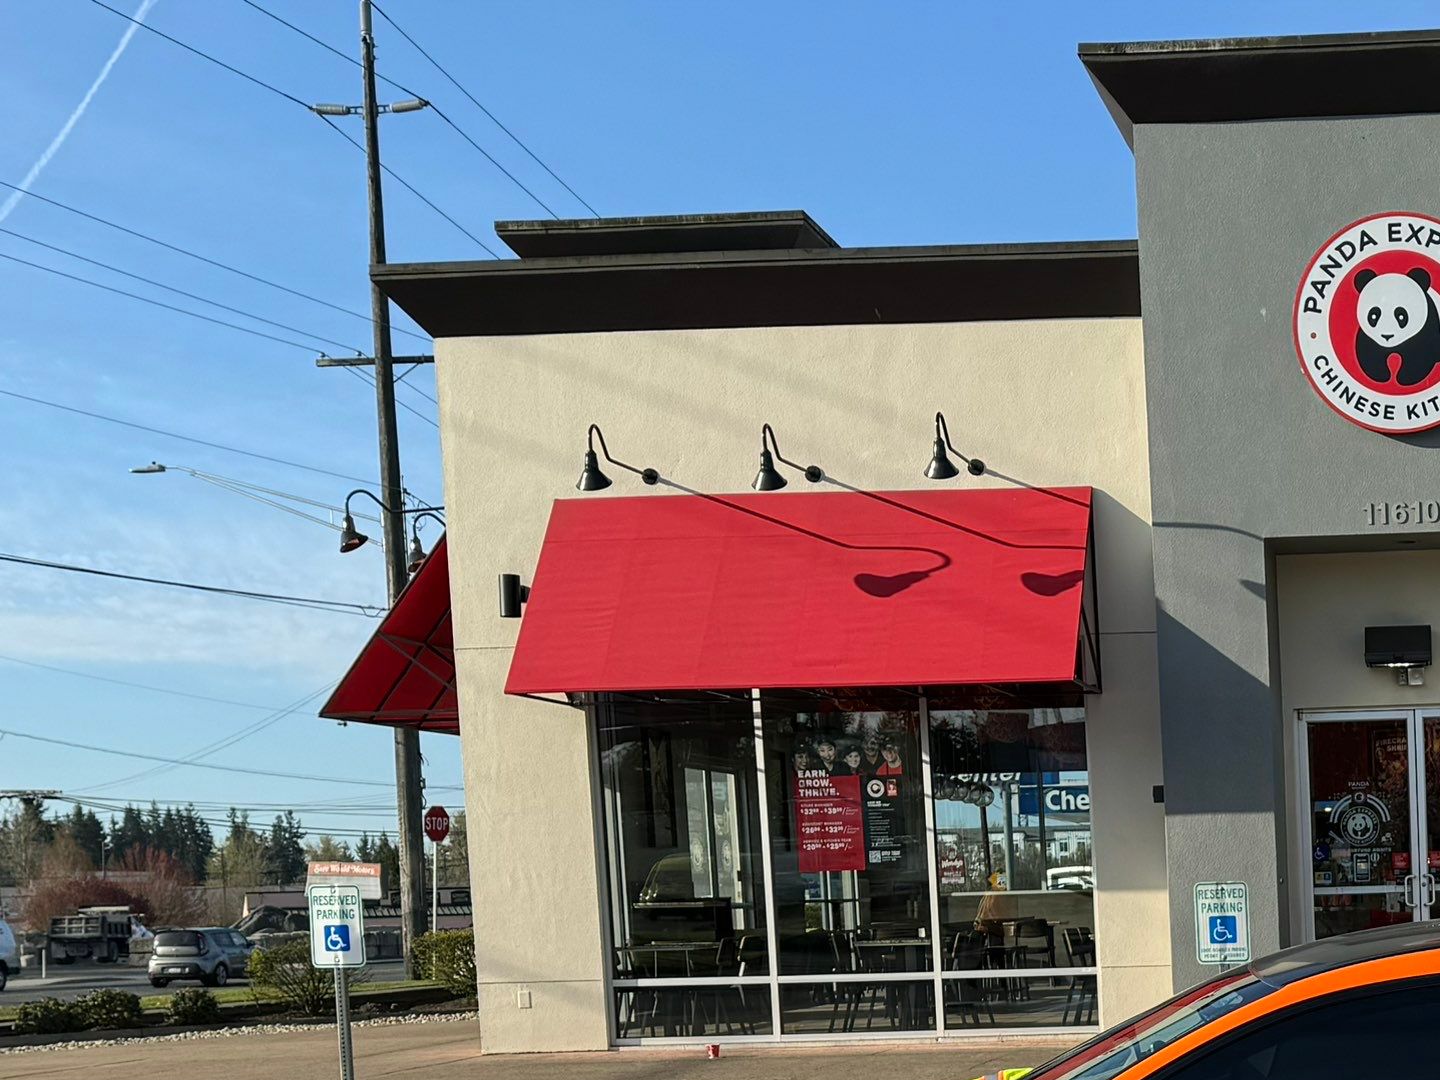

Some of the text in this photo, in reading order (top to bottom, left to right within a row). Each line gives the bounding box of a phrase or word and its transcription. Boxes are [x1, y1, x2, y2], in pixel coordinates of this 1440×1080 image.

[1303, 229, 1378, 314] PANDA
[1313, 355, 1396, 421] CHINESE
[798, 770, 829, 778] EARN.
[799, 788, 839, 797] THRIVE.
[426, 817, 449, 831] STOP
[1198, 888, 1244, 900] RESERVED
[312, 895, 357, 906] RESERVED
[1201, 902, 1243, 913] PARKING
[317, 909, 355, 920] PARKING
